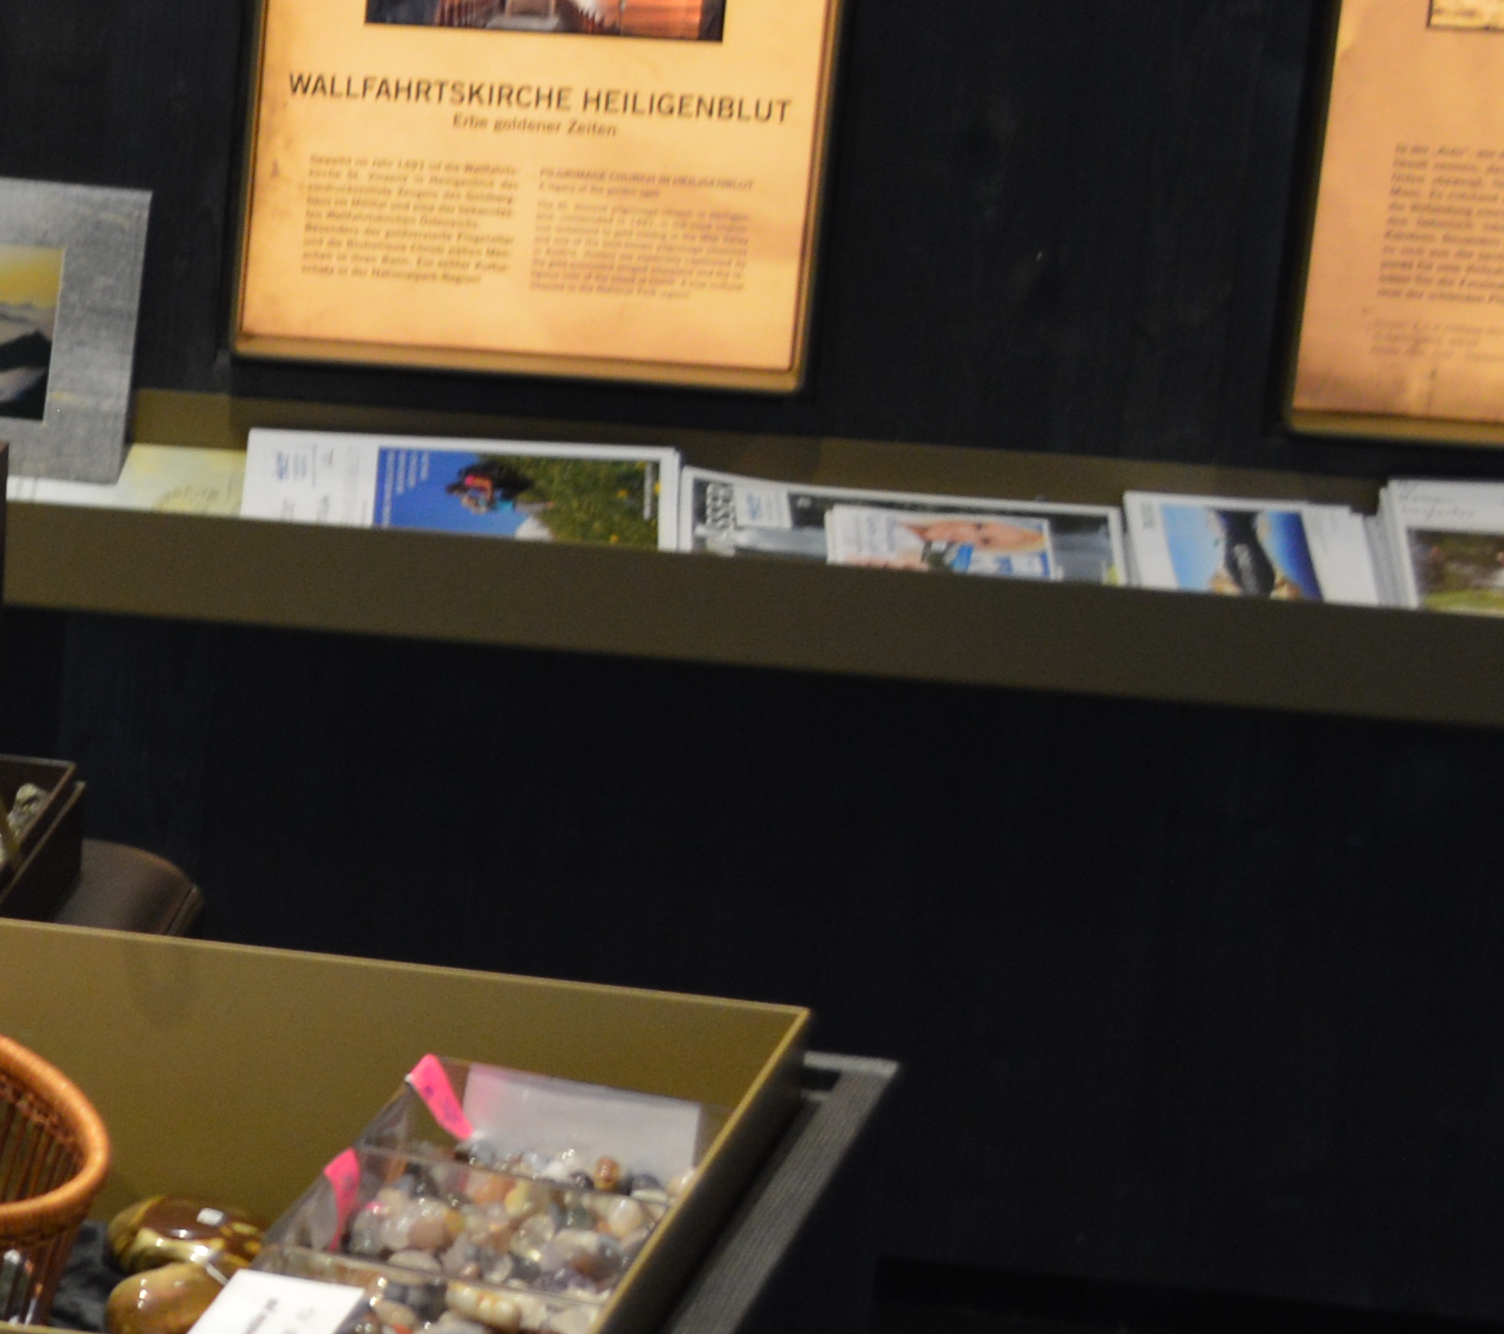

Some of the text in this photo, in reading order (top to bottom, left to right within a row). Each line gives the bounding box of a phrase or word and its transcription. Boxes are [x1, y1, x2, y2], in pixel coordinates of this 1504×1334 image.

[289, 72, 792, 125] WALLFAHRTSKIRCHE HEILIGENBLUT
[452, 114, 618, 138] Erbe goldener Zeiten
